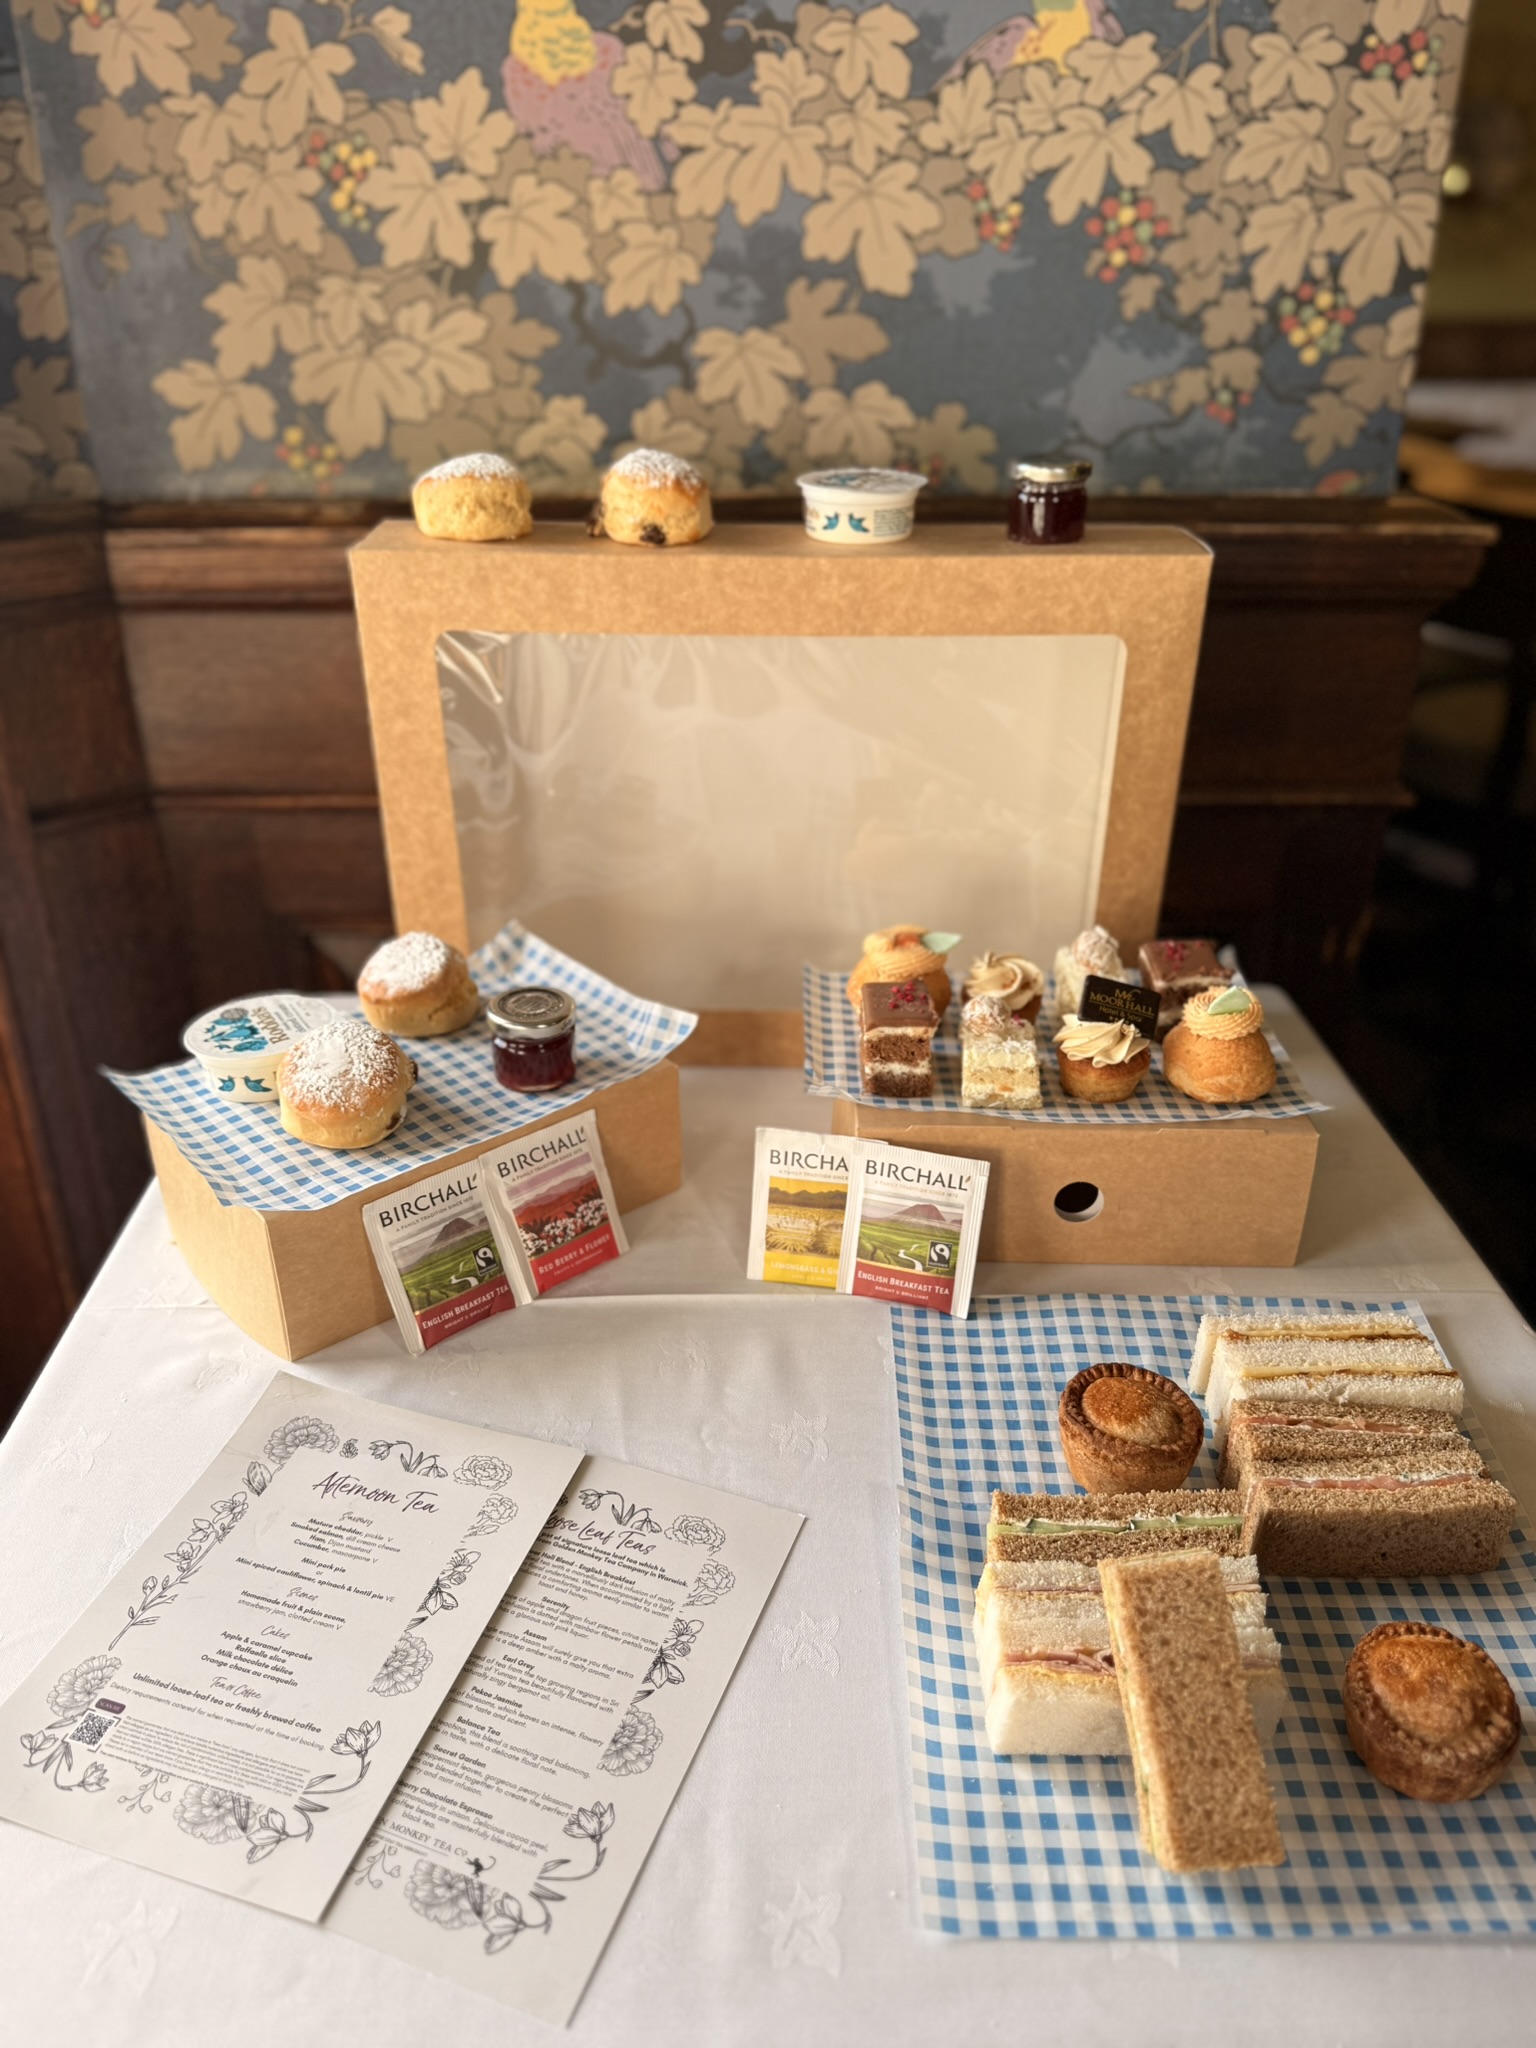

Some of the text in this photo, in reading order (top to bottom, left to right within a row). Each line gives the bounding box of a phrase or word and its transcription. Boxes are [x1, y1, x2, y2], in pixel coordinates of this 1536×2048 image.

[497, 1129, 586, 1178] BIRCHALL
[770, 1150, 850, 1171] BIRCHA
[866, 1160, 969, 1190] BIRCHALL
[379, 1175, 477, 1228] BIRCHALL
[401, 1219, 419, 1230] FAMILY
[421, 1207, 447, 1221] TRADITION
[538, 1261, 554, 1274] RED
[555, 1249, 578, 1266] BERRY
[858, 1271, 949, 1295] ENGLISH BREAKFAST TEA
[422, 1284, 508, 1329] ENGLISH BREAKFAST TEA
[313, 1472, 439, 1513] Afternoon Tea
[291, 1522, 319, 1532] Smoked
[318, 1530, 343, 1539] salmon,
[356, 1539, 377, 1547] cream
[378, 1544, 400, 1552] cheese
[308, 1518, 333, 1528] Mature
[334, 1525, 363, 1536] cheddar,
[578, 1521, 615, 1545] Leaf
[616, 1531, 656, 1555] Teas
[294, 1539, 329, 1553] Cucumber,
[328, 1539, 344, 1547] Dijon
[345, 1545, 372, 1554] mustard
[562, 1538, 592, 1550] signature
[593, 1547, 611, 1556] loose
[612, 1552, 626, 1560] leaf
[639, 1562, 658, 1571] which
[301, 1557, 318, 1565] Mini
[541, 1552, 556, 1560] Hall
[555, 1557, 575, 1566] Blend
[579, 1564, 602, 1575] English
[603, 1571, 636, 1585] Breakfast
[553, 1542, 576, 1552] Golden
[576, 1549, 602, 1562] Monkey
[604, 1557, 616, 1565] Tea
[617, 1561, 649, 1576] Company
[658, 1573, 688, 1587] Warwick.
[236, 1557, 252, 1565] Mini
[252, 1563, 277, 1572] spiced
[277, 1569, 315, 1583] cauliflower,
[318, 1580, 345, 1590] spinach
[353, 1587, 372, 1596] lentil
[241, 1590, 280, 1605] Homemade
[282, 1601, 297, 1609] fruit
[287, 1587, 318, 1601] Scones
[542, 1596, 570, 1610] Serenity
[238, 1600, 271, 1613] strawberry
[288, 1613, 313, 1623] clotted
[313, 1620, 334, 1629] cream
[261, 1626, 290, 1639] Cakes
[523, 1630, 547, 1641] Assam
[221, 1631, 242, 1641] Apple
[250, 1641, 282, 1652] caramel
[281, 1650, 312, 1661] cupcake
[216, 1649, 233, 1658] Milk
[233, 1655, 269, 1668] chocolate
[269, 1655, 286, 1663] slice
[503, 1655, 535, 1672] Earl Grey
[201, 1655, 228, 1667] Orange
[229, 1663, 251, 1673] choux
[263, 1674, 297, 1687] craquelin
[210, 1677, 227, 1689] Tea
[133, 1673, 171, 1689] Unlimited
[170, 1684, 211, 1701] loose-leaf
[210, 1697, 224, 1705] tea
[235, 1703, 262, 1717] freshly
[263, 1711, 295, 1725] brewed
[295, 1722, 321, 1733] coffee
[471, 1686, 523, 1708] Pekoe Jasmine
[110, 1682, 132, 1694] Dietary
[132, 1690, 171, 1705] requirements
[172, 1703, 197, 1712] catered
[224, 1718, 256, 1729] requested
[276, 1732, 290, 1740] time
[457, 1716, 501, 1736] Balance Tea
[433, 1744, 486, 1768] Secret Garden
[396, 1779, 493, 1819] berry Chocolate Espresso
[390, 1822, 430, 1842] MONKEY
[434, 1839, 451, 1852] TEA
